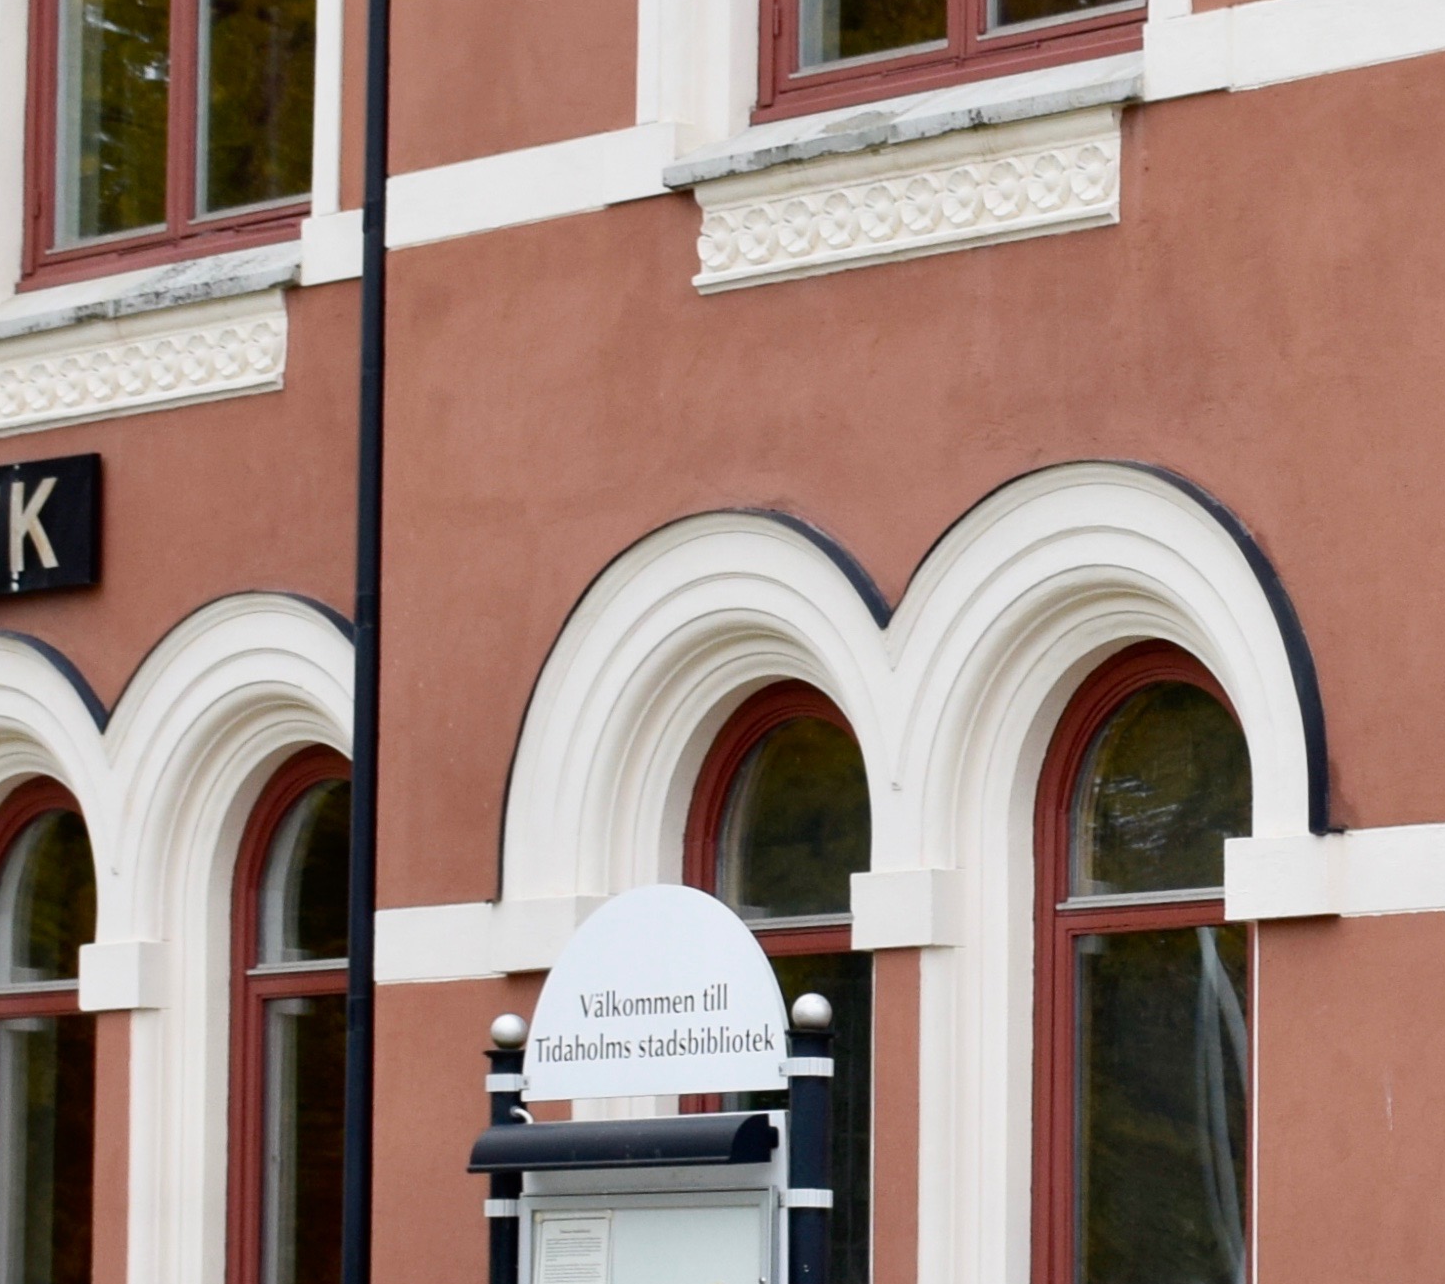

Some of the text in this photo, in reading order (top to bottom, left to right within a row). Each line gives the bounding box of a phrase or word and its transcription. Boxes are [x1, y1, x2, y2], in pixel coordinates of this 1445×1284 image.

[580, 983, 728, 1019] Välkommen till
[535, 1024, 775, 1063] Tidaholms stadsbibliotek
